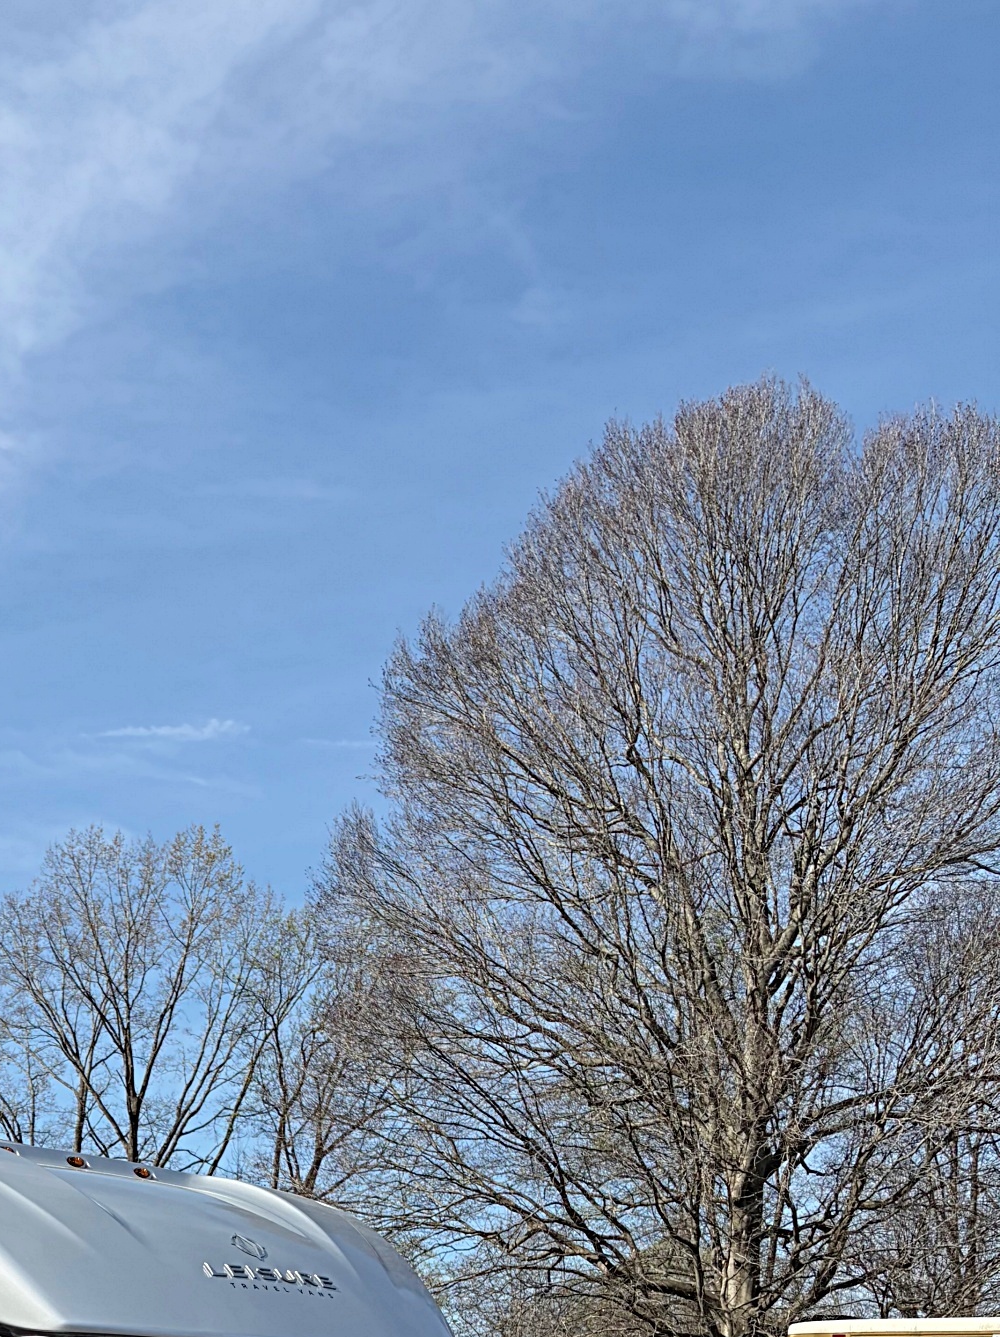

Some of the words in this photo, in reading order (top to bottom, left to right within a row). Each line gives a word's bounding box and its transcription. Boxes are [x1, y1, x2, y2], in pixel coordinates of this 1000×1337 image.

[202, 1262, 337, 1291] LEISURE
[230, 1282, 290, 1293] TRAVEL
[297, 1288, 334, 1299] VANS
